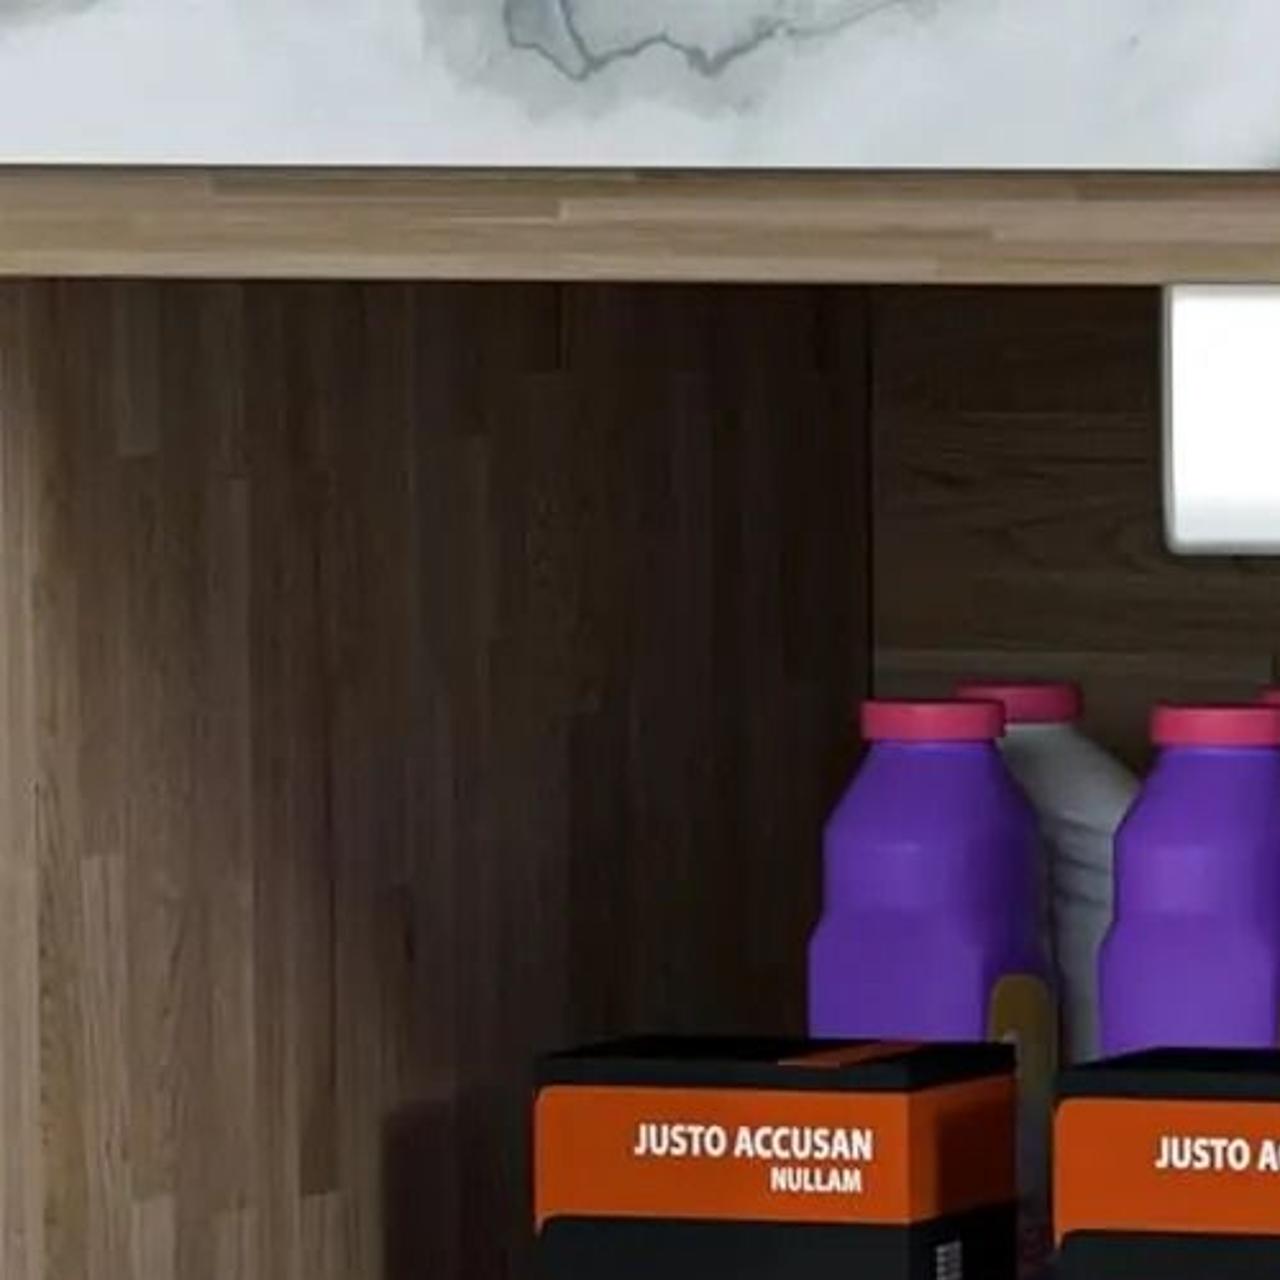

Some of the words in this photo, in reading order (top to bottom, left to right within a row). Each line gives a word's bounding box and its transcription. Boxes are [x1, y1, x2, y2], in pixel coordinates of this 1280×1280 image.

[634, 1124, 727, 1157] JUSTO
[734, 1126, 873, 1160] ACCUSAN
[1155, 1137, 1250, 1170] JUSTO
[771, 1167, 862, 1193] NULLAM
